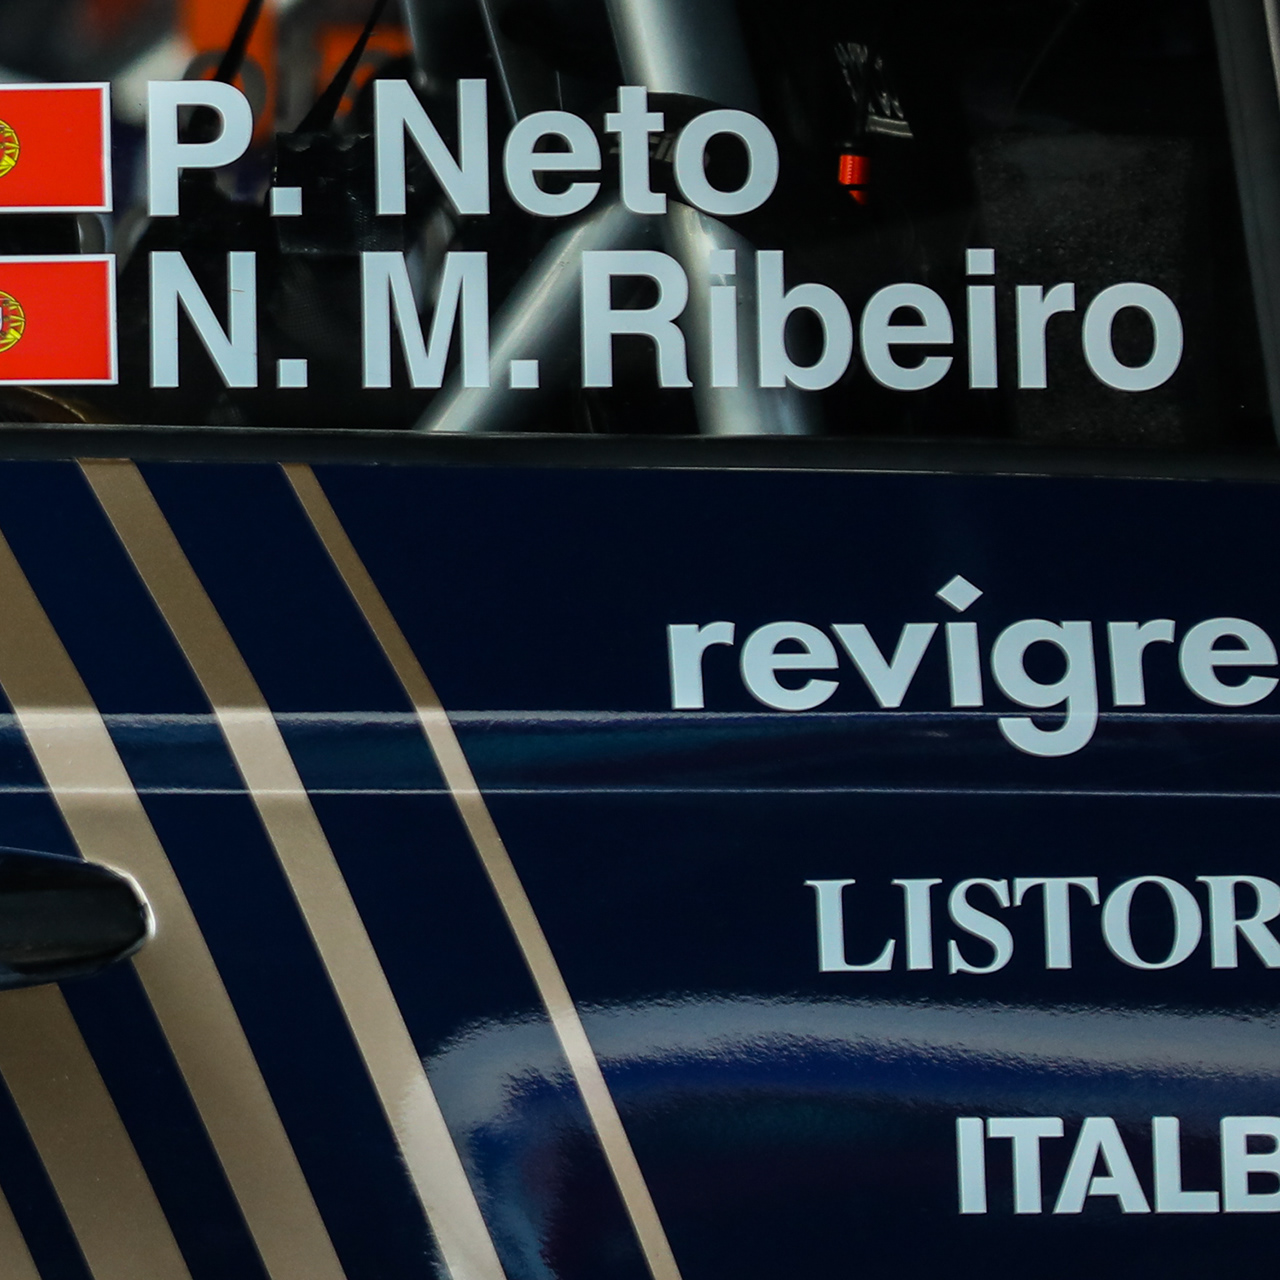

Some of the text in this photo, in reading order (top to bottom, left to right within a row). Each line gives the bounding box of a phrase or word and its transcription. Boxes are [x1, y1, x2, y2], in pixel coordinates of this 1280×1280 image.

[146, 79, 303, 217] P.
[375, 79, 779, 217] Neto
[149, 247, 1185, 391] N. M. Ribeiro
[668, 575, 1280, 756] revigre
[805, 875, 1280, 974] LISTOR
[956, 1116, 1280, 1214] ITALB
